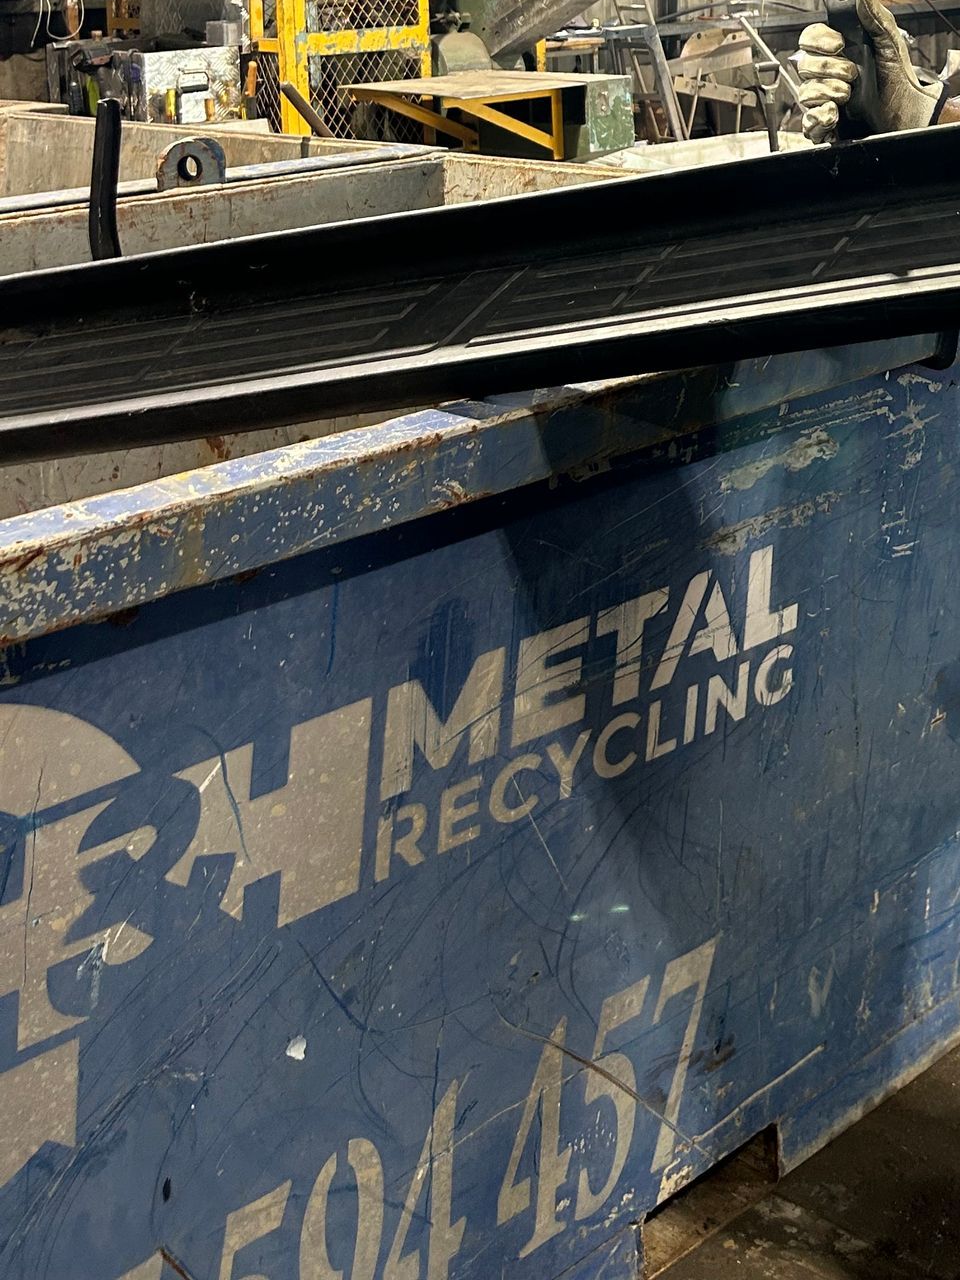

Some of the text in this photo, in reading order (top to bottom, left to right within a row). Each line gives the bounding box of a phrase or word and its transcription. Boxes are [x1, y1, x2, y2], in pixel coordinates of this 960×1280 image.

[374, 644, 795, 883] RECYCLING
[379, 545, 798, 802] METAL
[497, 933, 722, 1259] 457
